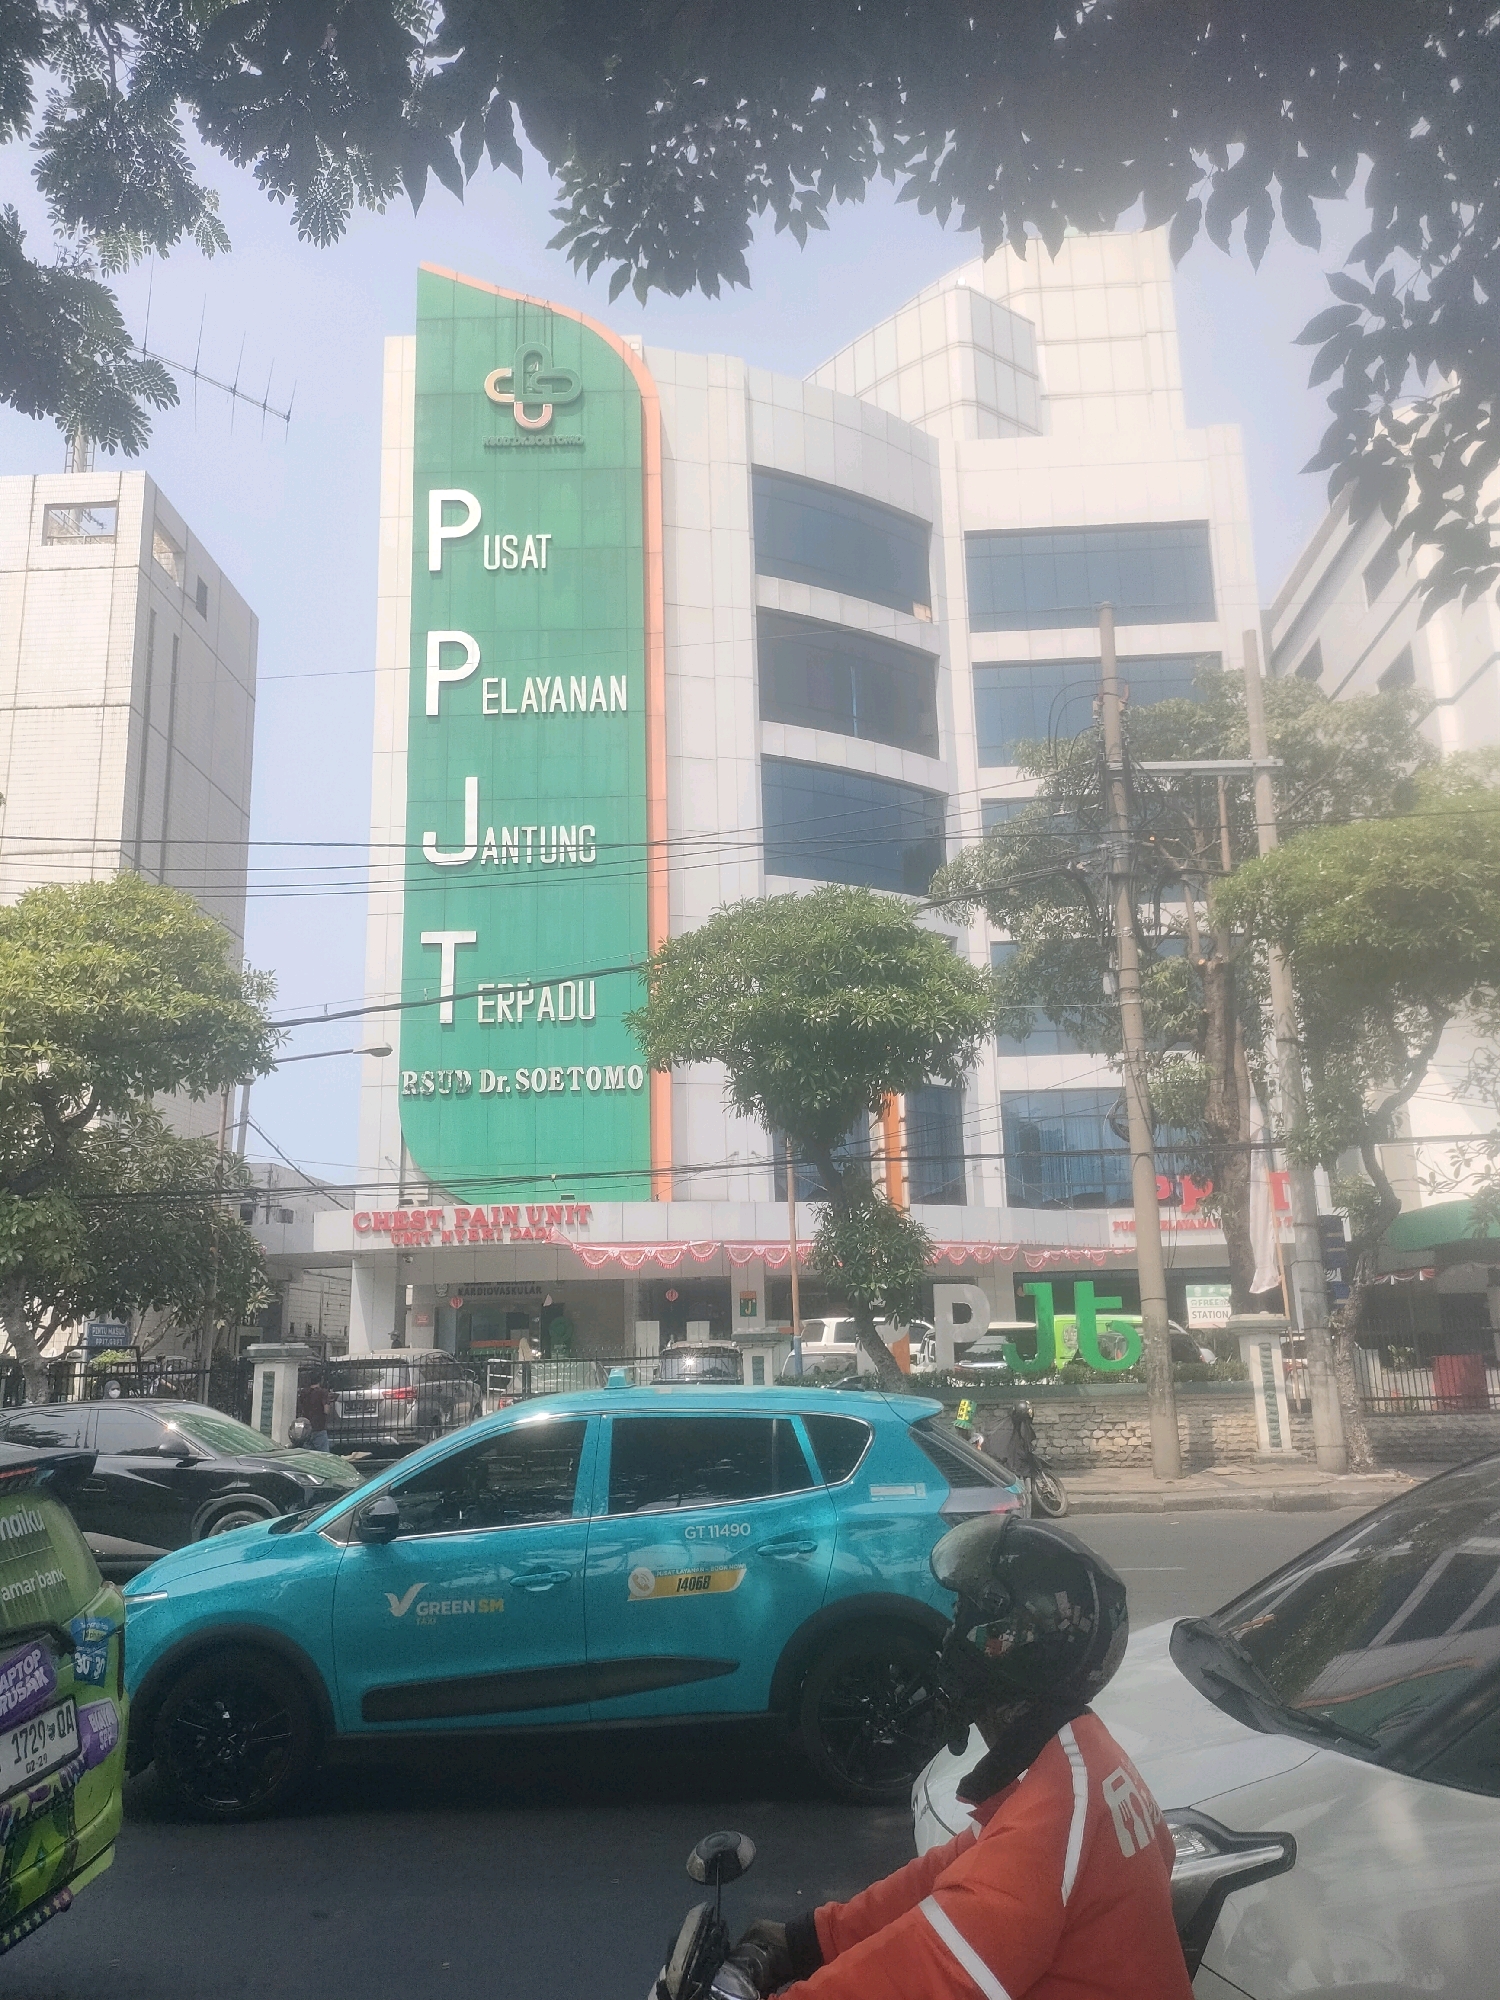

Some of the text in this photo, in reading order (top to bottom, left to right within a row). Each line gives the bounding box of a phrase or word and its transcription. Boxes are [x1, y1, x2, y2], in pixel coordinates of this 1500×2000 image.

[428, 488, 552, 572] PUSAT
[425, 630, 628, 717] PELAYANAN
[422, 776, 597, 867] JANTUNG
[420, 930, 597, 1025] TERPADU
[401, 1065, 643, 1096] RSUD Dr. SOETOMO
[353, 1205, 591, 1232] CHEST PAIN UNIT
[391, 1230, 433, 1246] UNIT
[441, 1227, 503, 1244] NYERI
[457, 1285, 543, 1297] KARDIOVASKULAR
[1191, 1310, 1229, 1319] STATION
[684, 1522, 751, 1539] GT 11490
[35, 1567, 67, 1588] bank
[676, 1575, 712, 1593] 14068
[416, 1598, 505, 1616] GREEN SM
[11, 1704, 75, 1765] 1729 QA
